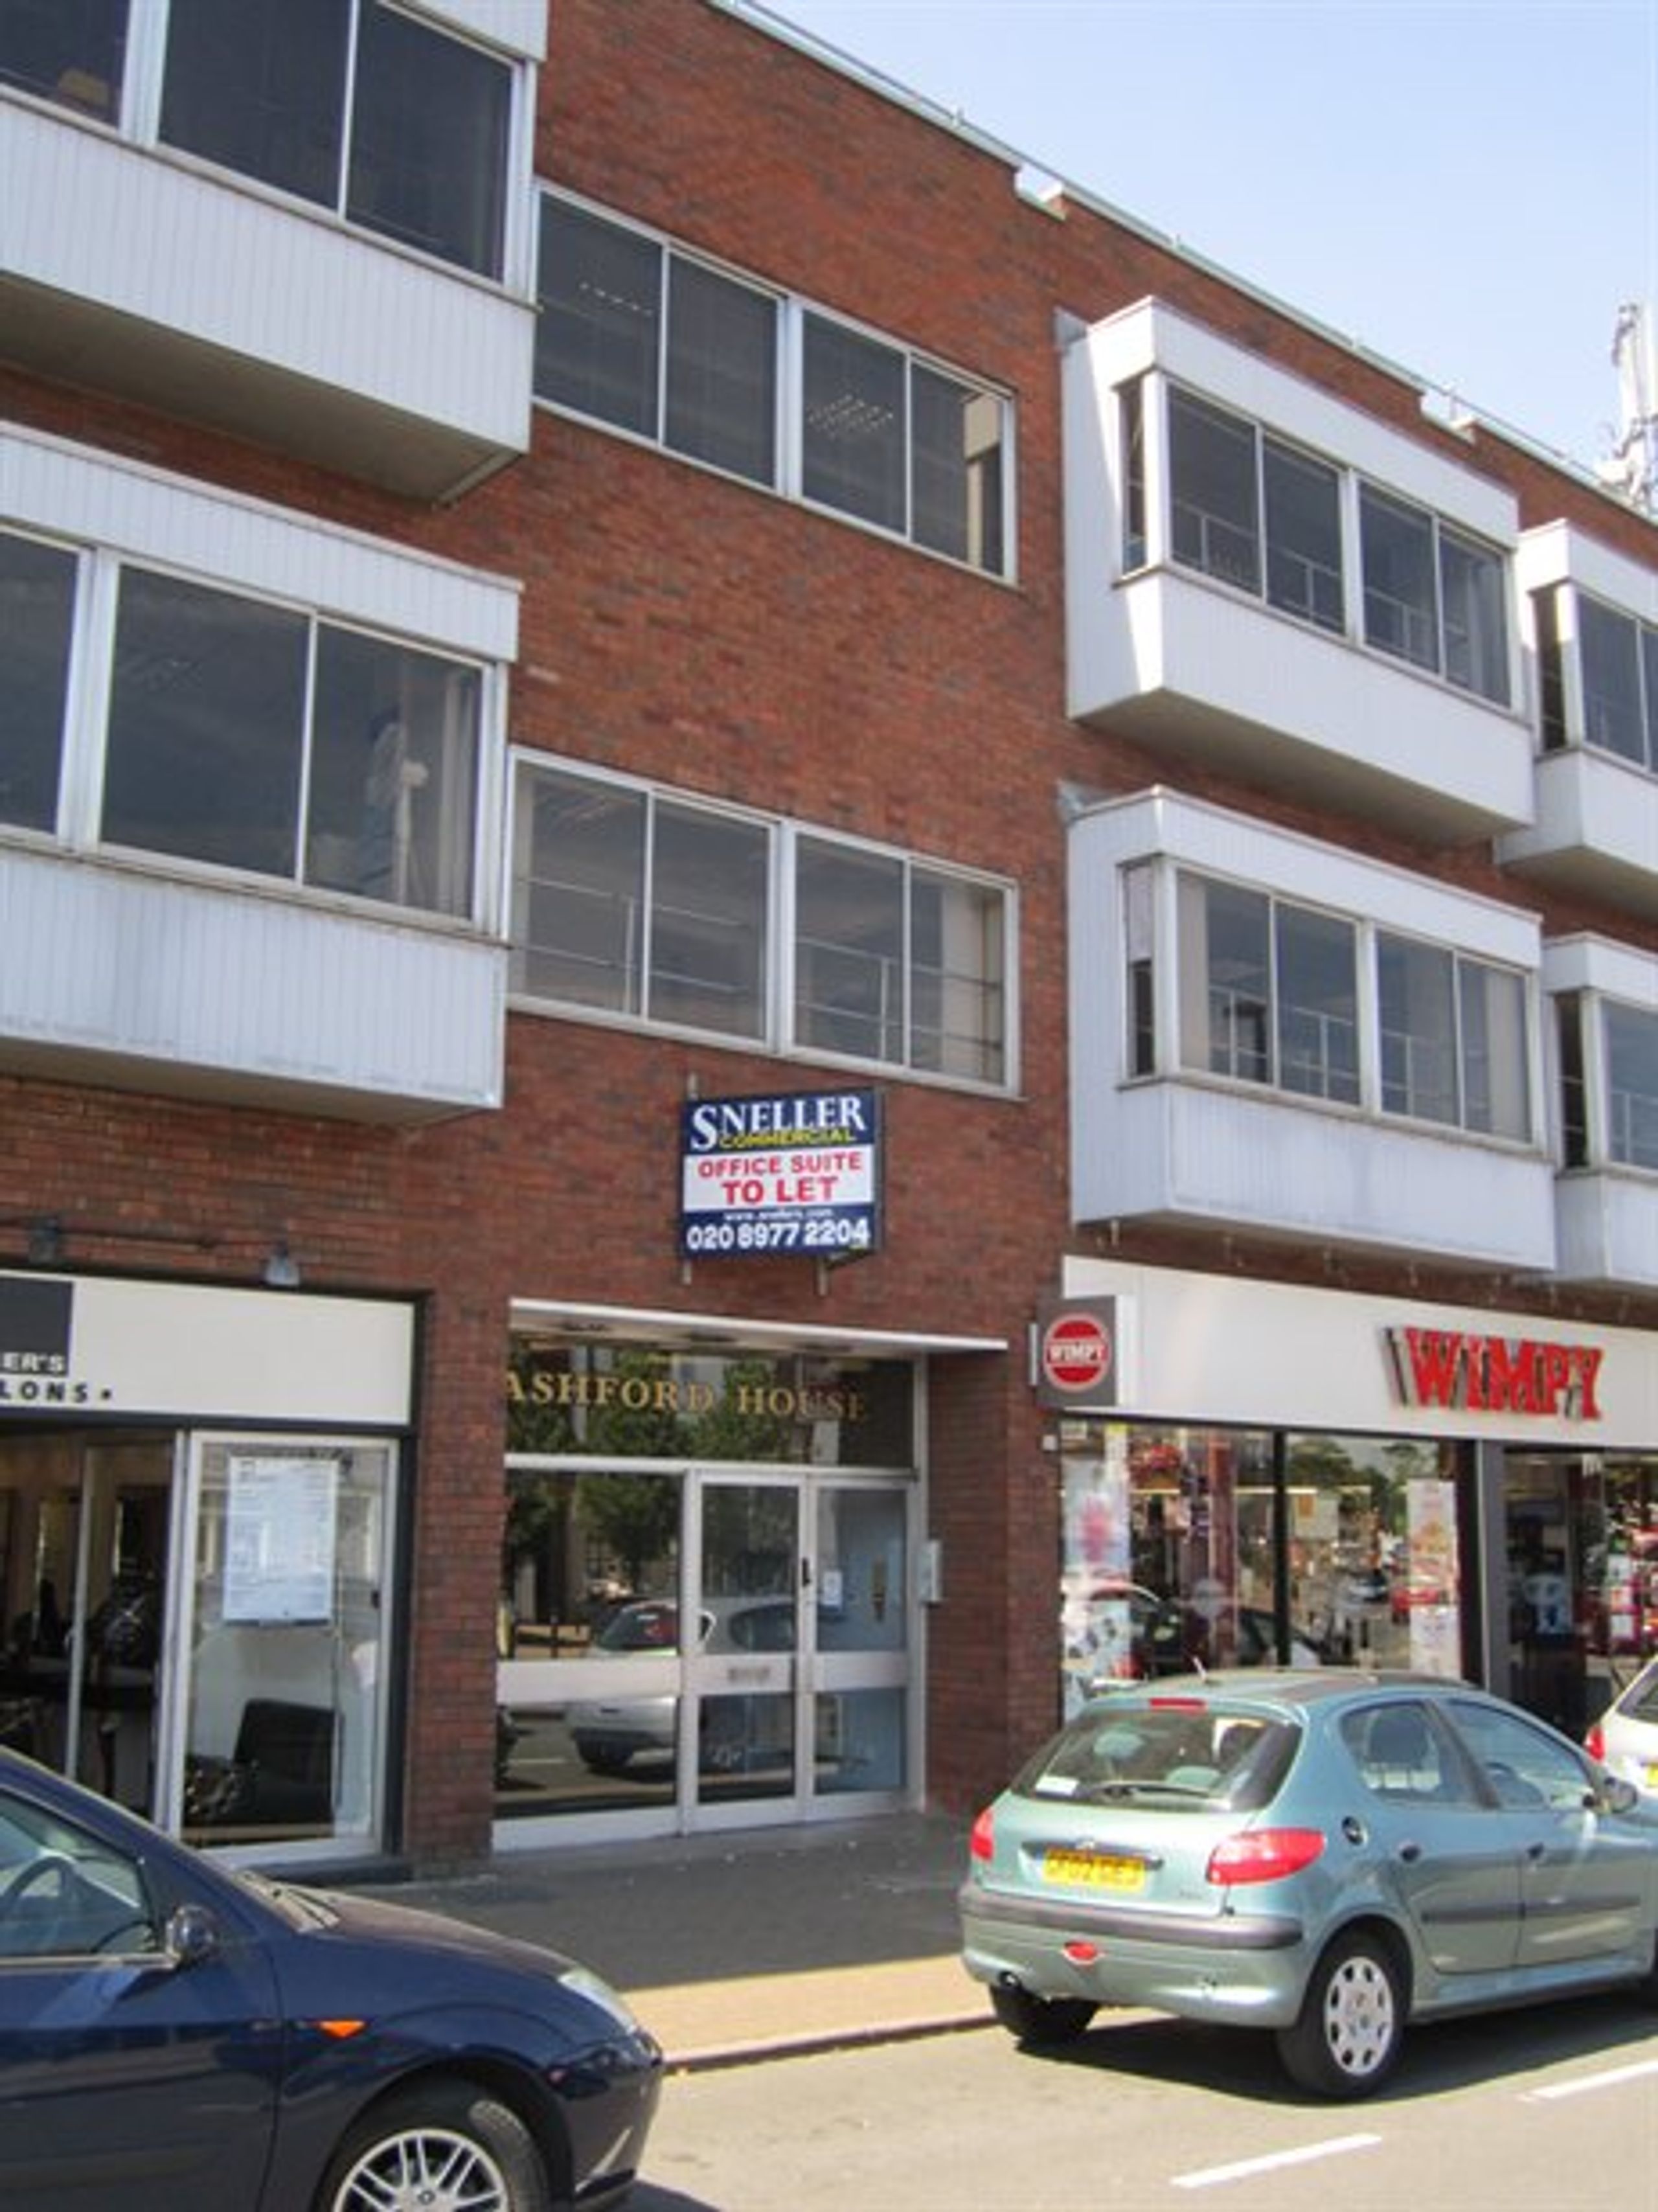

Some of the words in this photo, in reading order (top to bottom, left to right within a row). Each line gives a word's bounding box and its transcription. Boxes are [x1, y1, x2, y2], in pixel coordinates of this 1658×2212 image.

[690, 1096, 865, 1151] SNELLER
[697, 1156, 782, 1178] OFFICE
[791, 1151, 862, 1174] SUITE
[721, 1180, 764, 1205] TO
[776, 1176, 838, 1203] LET
[687, 1224, 735, 1250] 020
[737, 1222, 800, 1249] 8977
[804, 1217, 870, 1249] 2204
[1402, 1325, 1604, 1422] WIMPY
[505, 1371, 714, 1412] ASHFORD
[736, 1384, 867, 1422] HOUSE
